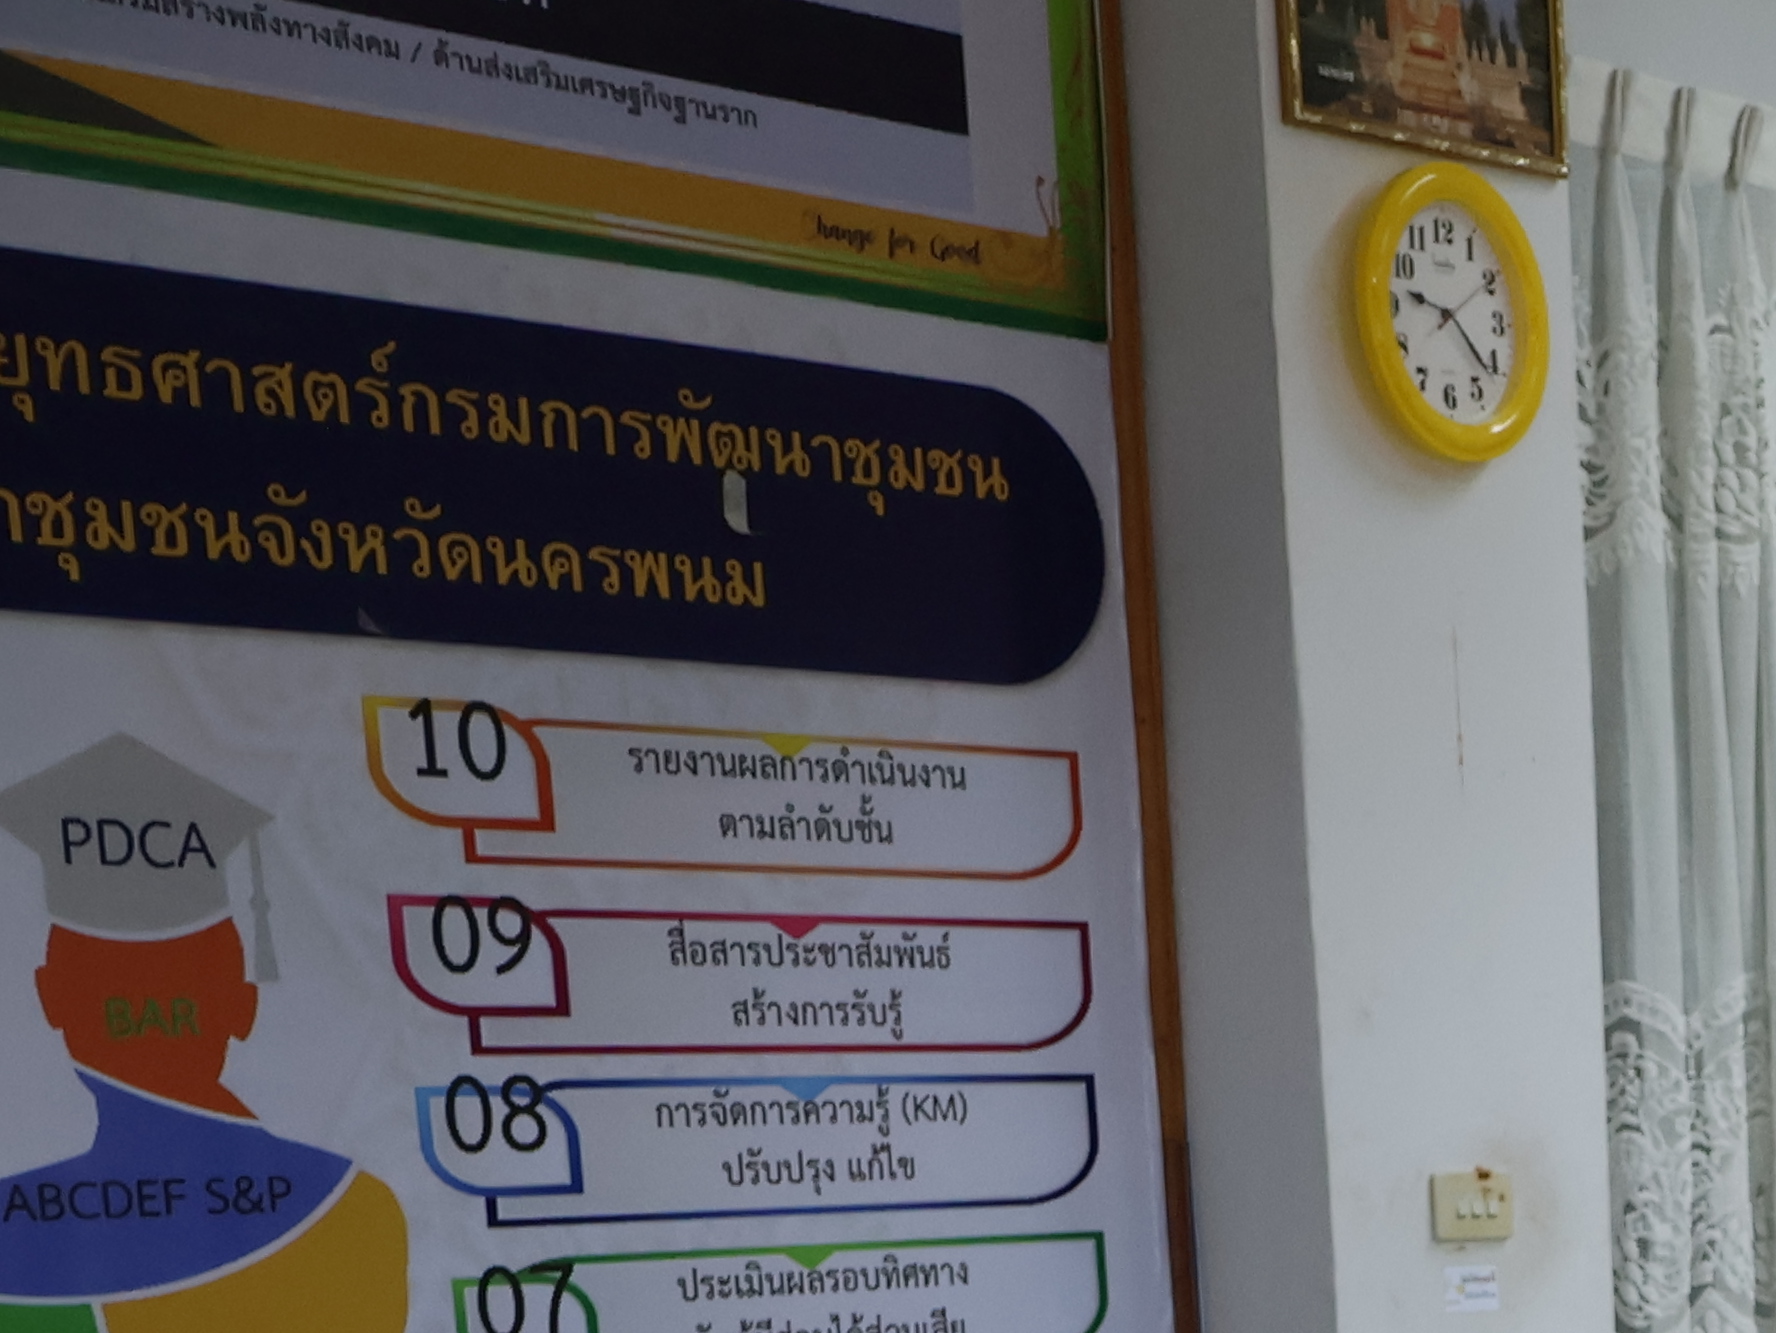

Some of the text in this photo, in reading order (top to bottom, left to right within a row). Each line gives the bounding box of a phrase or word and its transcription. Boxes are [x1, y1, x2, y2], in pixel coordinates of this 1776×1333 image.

[930, 235, 983, 267] Good
[1408, 224, 1426, 252] 11
[1432, 218, 1454, 245] 12
[1466, 234, 1474, 262] 1
[1395, 253, 1416, 280] 10
[1481, 267, 1496, 297] 2
[1490, 310, 1506, 338] 3
[1415, 365, 1428, 393] 7
[1442, 383, 1458, 411] 6
[1469, 375, 1484, 402] 5
[408, 698, 508, 781] 10
[627, 746, 967, 791] รายงานผลการดำเนินงาน
[718, 792, 894, 845] ตามลำดับชั้น
[61, 816, 217, 870] PDCA
[431, 894, 533, 976] 09
[666, 917, 953, 970] สื่อสารประชาสัมพันธ์
[105, 995, 201, 1040] BAR
[732, 986, 904, 1042] สร้างการรับรู้
[445, 1074, 548, 1154] 08
[655, 1084, 968, 1137] การจัดการความรู้ (KM)
[721, 1142, 916, 1197] ปรับปรุง แก้ไข
[2, 1175, 293, 1223] ABCDEF S&P
[676, 1253, 970, 1303] ประเมินผลรอบทิศทาง
